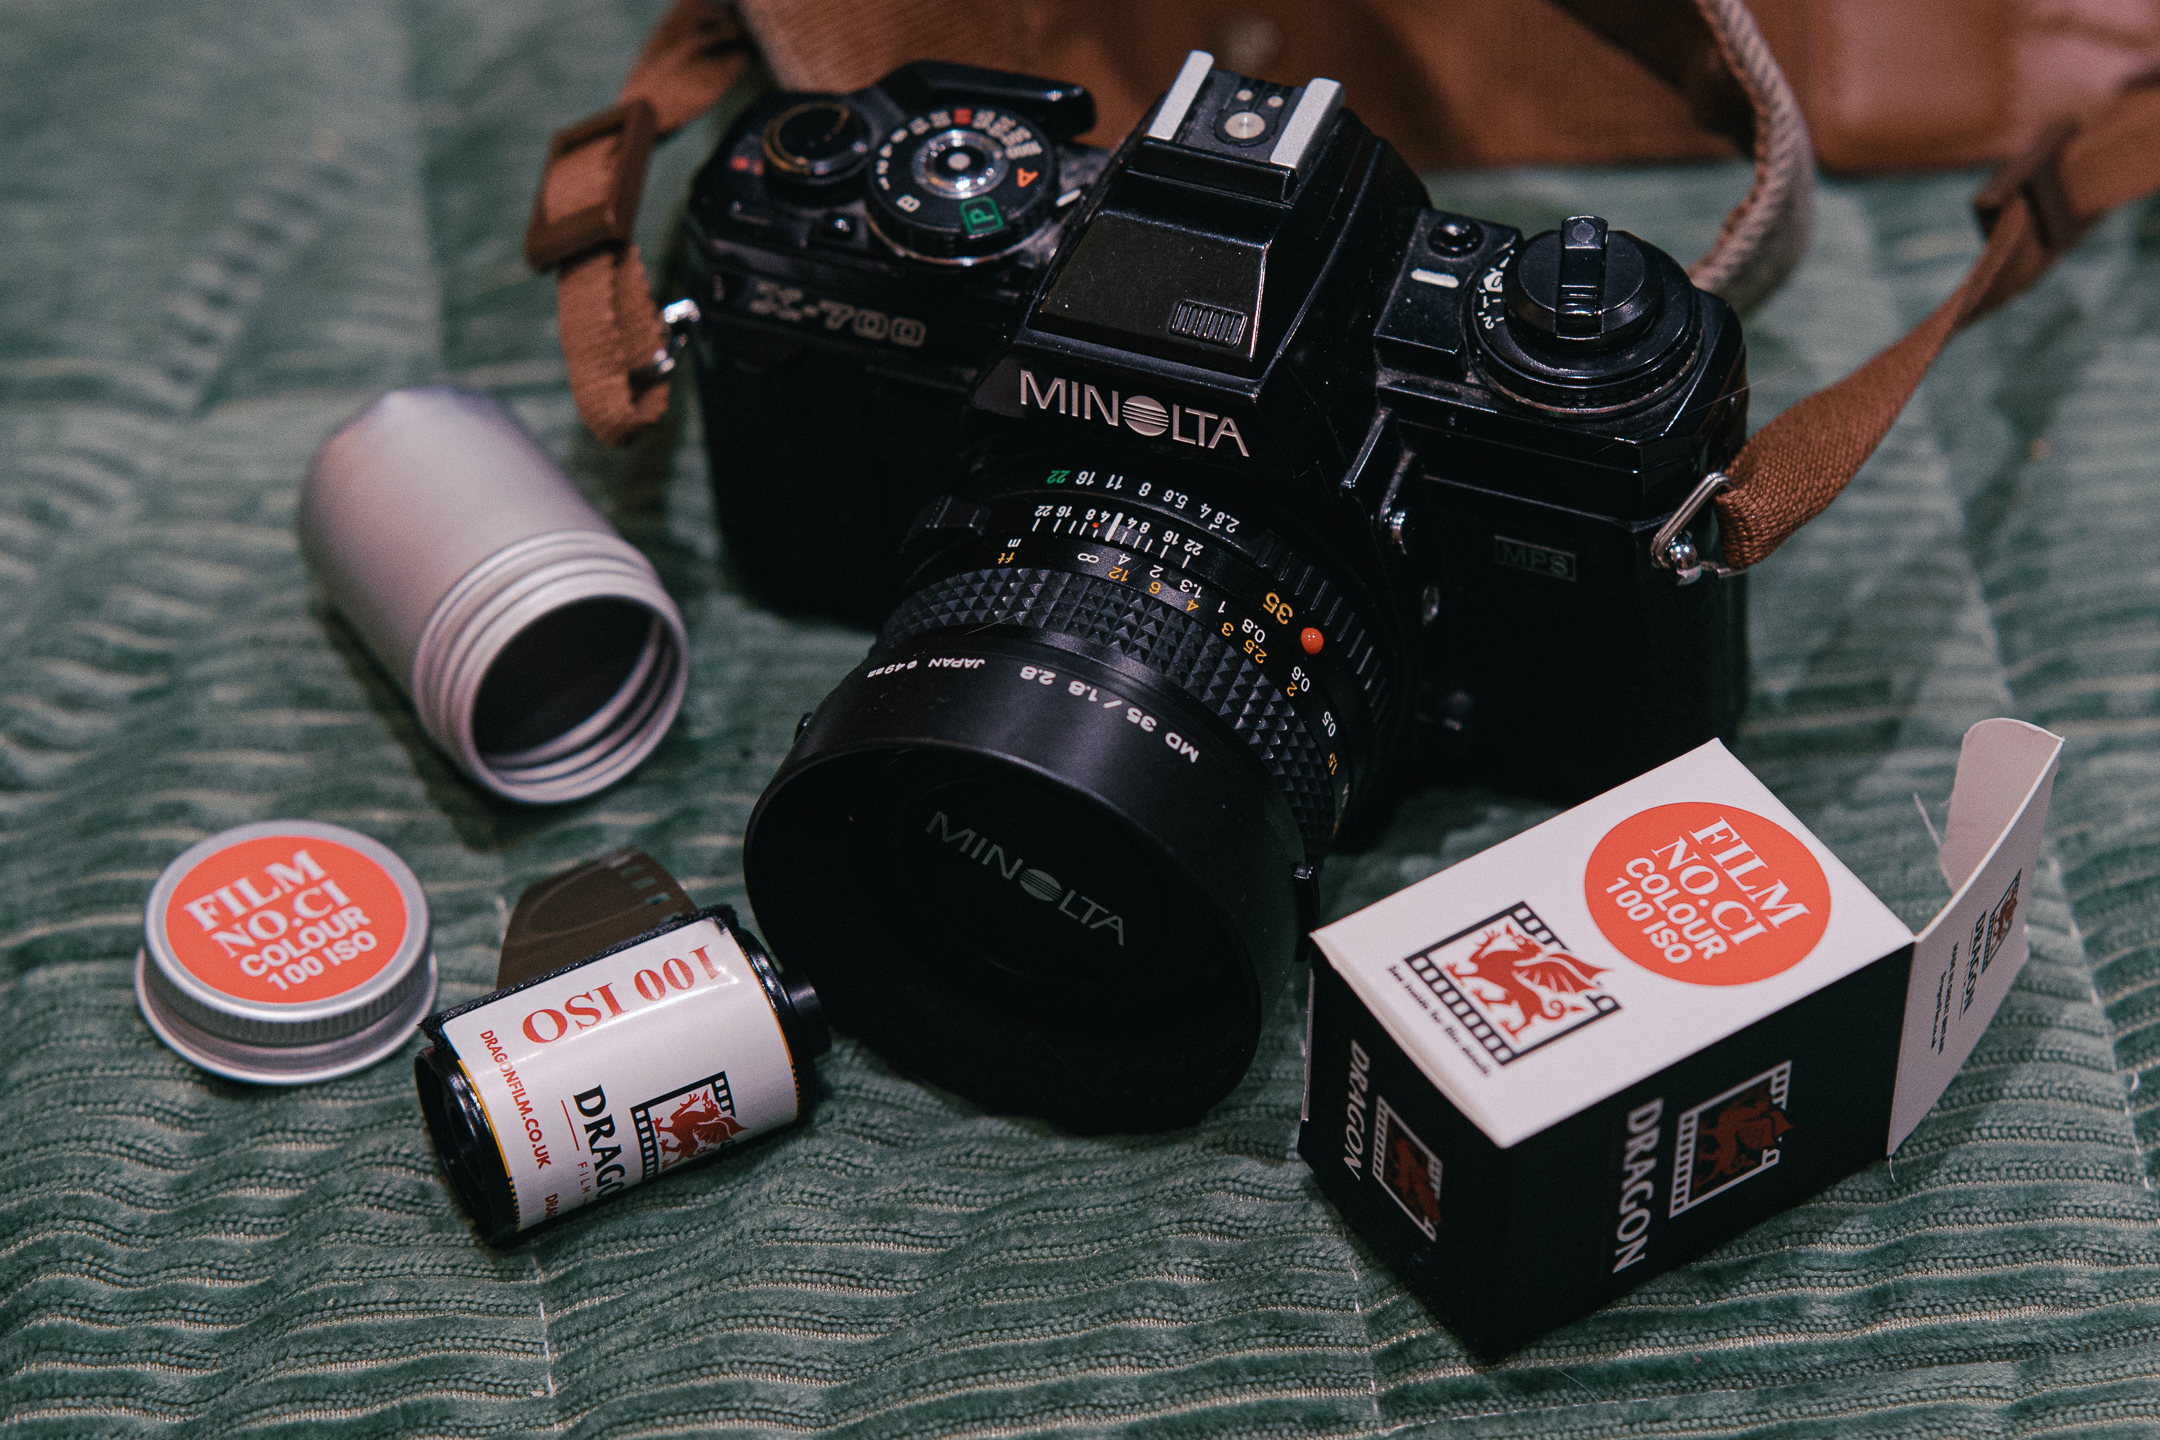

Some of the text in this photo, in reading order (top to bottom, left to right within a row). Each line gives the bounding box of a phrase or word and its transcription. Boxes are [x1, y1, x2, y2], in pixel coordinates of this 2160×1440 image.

[1017, 168, 1038, 187] A
[896, 194, 921, 213] B
[752, 280, 926, 347] X-700
[1482, 315, 1495, 330] 2
[1020, 369, 1249, 457] MINOLTA
[1047, 470, 1240, 533] 2.8 4 5.6 8 11 16 22
[1008, 538, 1021, 548] m
[1034, 505, 1203, 556] 22 16 8 4 4 8 16 22
[998, 552, 1014, 564] ft
[1118, 553, 1131, 565] 4
[1150, 565, 1163, 578] 2
[1502, 541, 1570, 577] MPS
[1109, 566, 1129, 582] 12
[1149, 581, 1161, 594] 6
[1180, 578, 1202, 598] 1.3
[1186, 599, 1199, 612] 4
[1218, 600, 1226, 613] 1
[1263, 592, 1293, 625] 35
[1221, 621, 1234, 636] 3
[1242, 618, 1265, 643] 0.8
[928, 658, 985, 669] JAPAN
[1243, 639, 1267, 664] 2.5
[1020, 666, 1056, 685] 2.8
[1286, 681, 1297, 697] 2
[1292, 666, 1310, 692] 0.6
[1322, 711, 1336, 737] 0.5
[1165, 732, 1199, 763] MD
[926, 811, 1124, 946] MINOLTA
[1689, 816, 1811, 930] FILM
[183, 850, 326, 931] FILM
[1605, 877, 1693, 964] 100 ISO
[1625, 857, 1728, 961] COLOUR
[239, 905, 371, 977] COLOUR
[267, 930, 377, 990] 100 ISO
[1963, 909, 1987, 1015] DRAGON
[522, 944, 723, 1044] 100 ISO
[480, 1029, 552, 1170] DRAGONFILM.CO.UK
[1342, 1040, 1371, 1180] DRAGON
[577, 1161, 592, 1195] FILM
[1612, 1098, 1664, 1274] DRAGON
